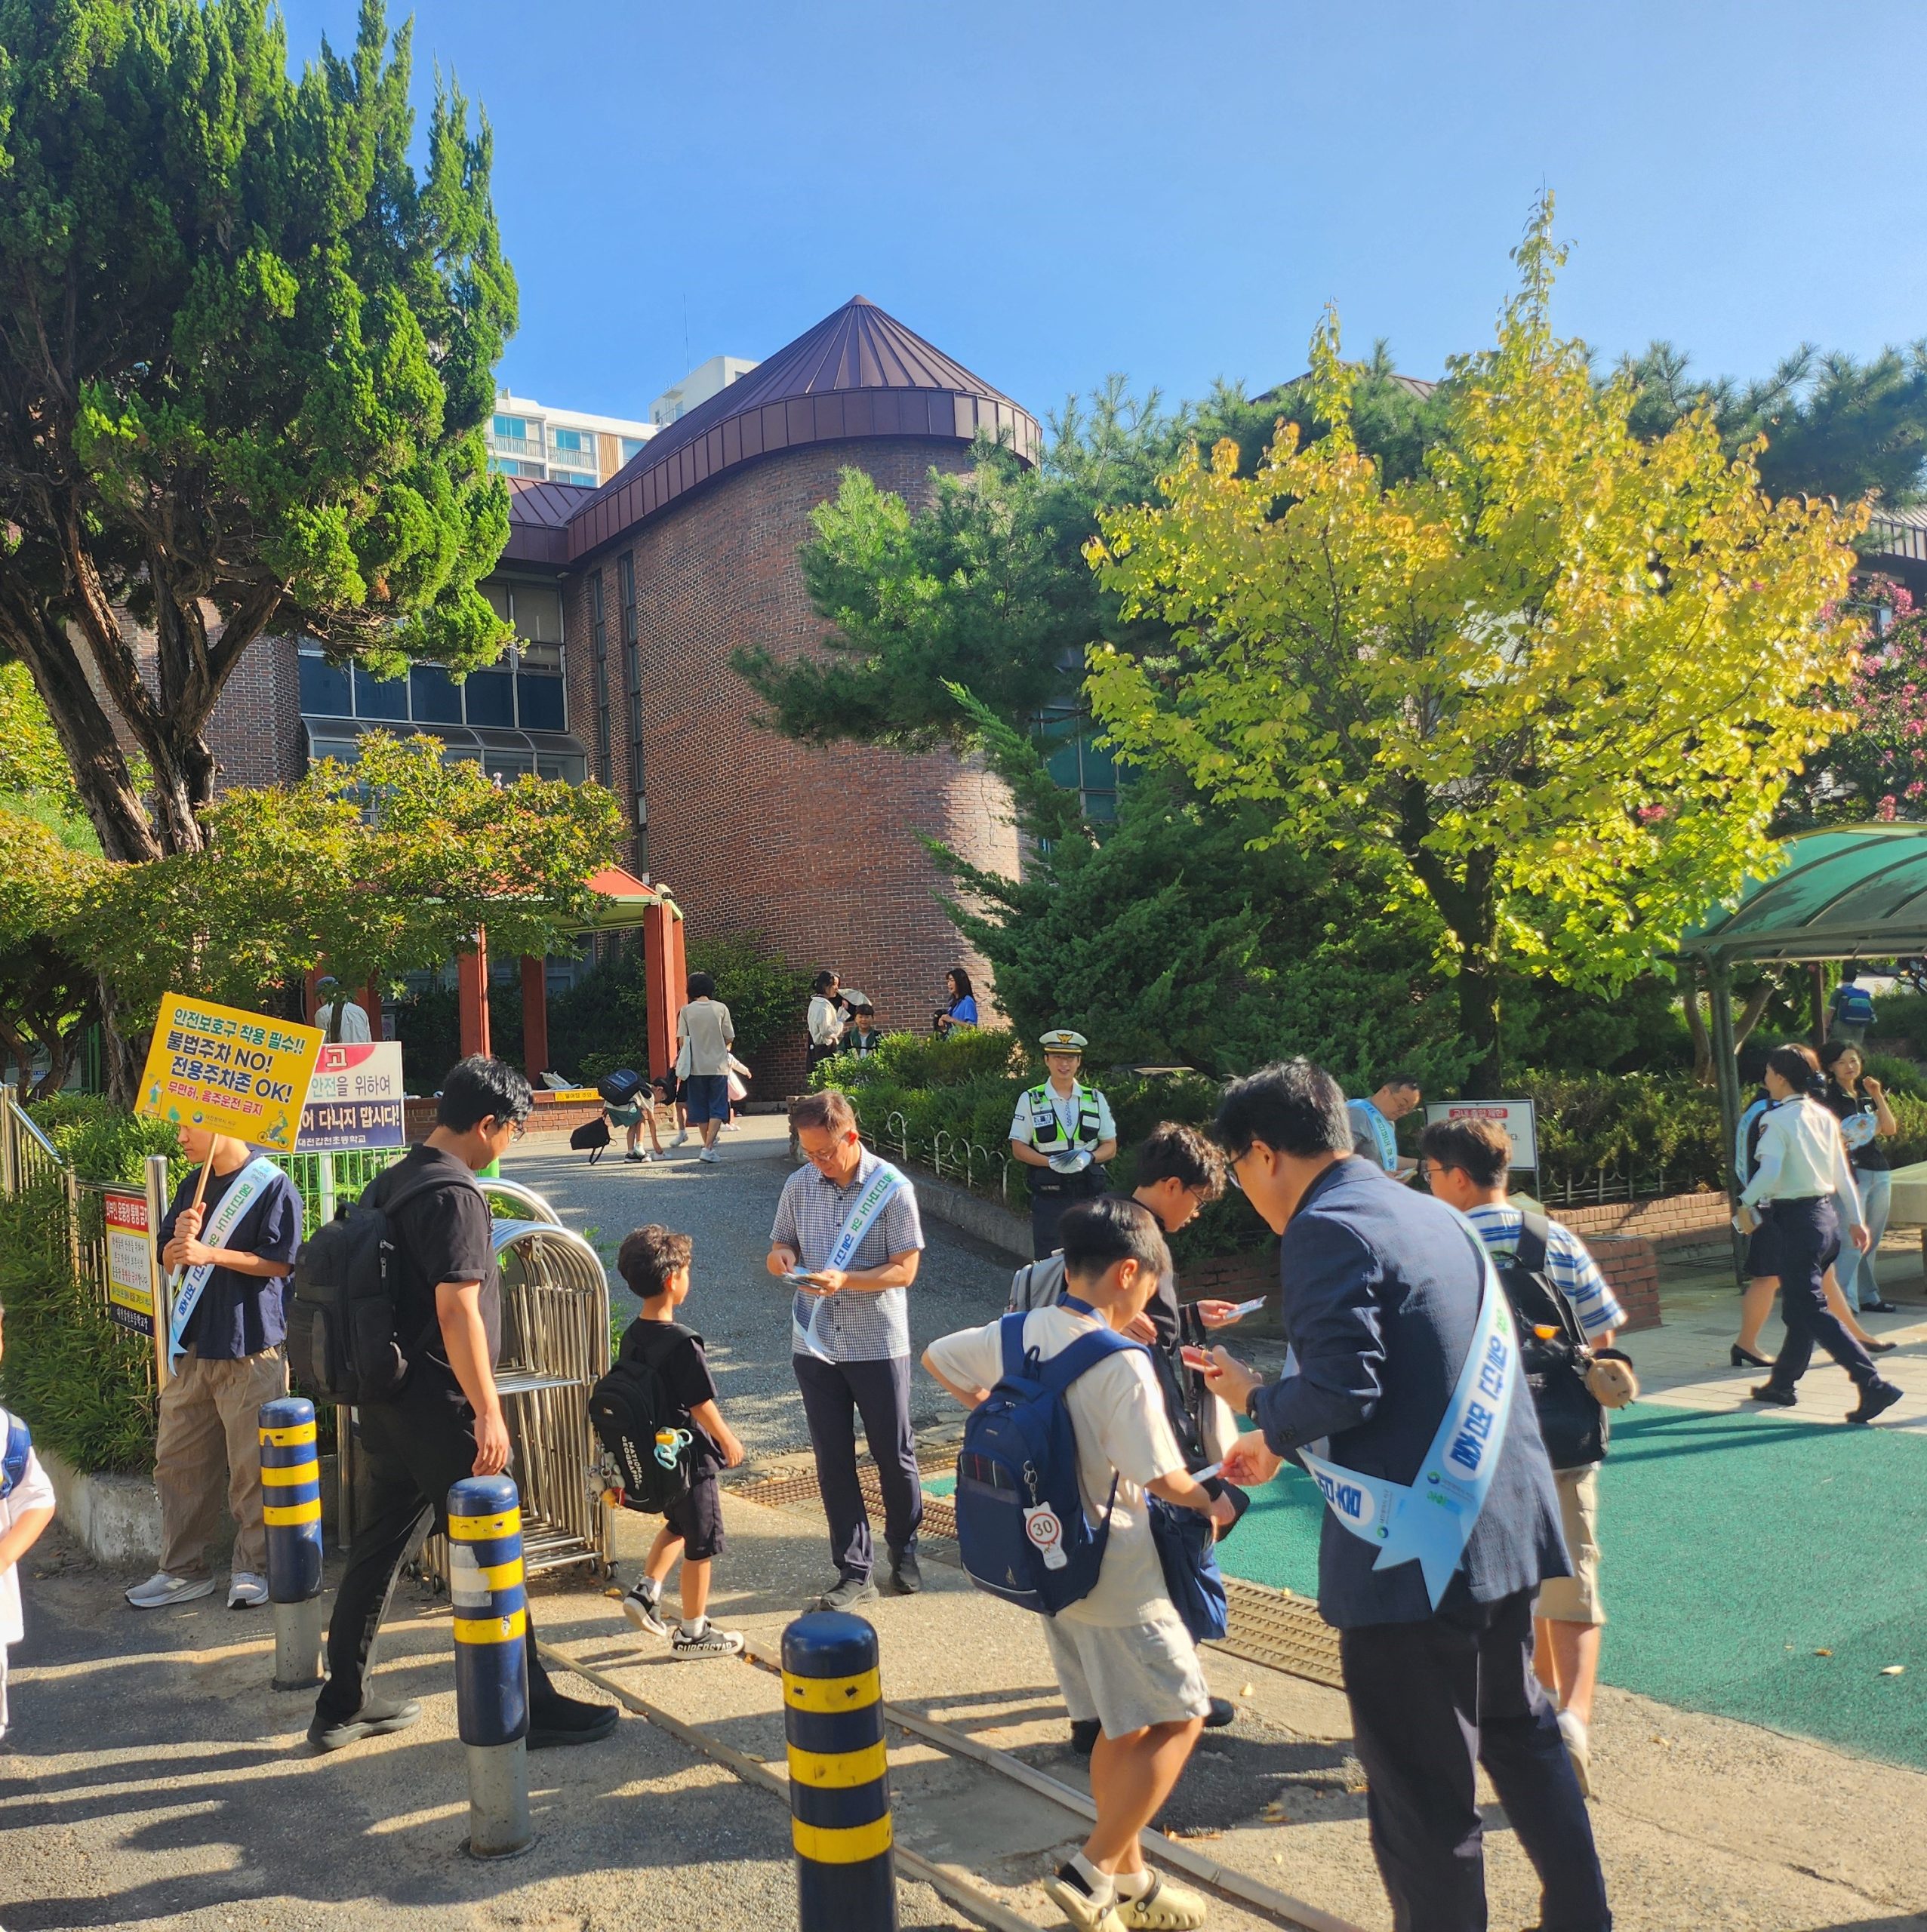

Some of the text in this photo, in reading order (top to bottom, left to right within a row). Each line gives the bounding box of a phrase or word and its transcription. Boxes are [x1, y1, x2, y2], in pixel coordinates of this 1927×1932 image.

[174, 1008, 306, 1054] 안전보호구 착용 필수!!
[166, 1030, 274, 1073] 불법주차 NO!
[326, 1048, 348, 1067] 고
[171, 1056, 293, 1103] 전용주차존 OK!
[312, 1074, 391, 1098] 안전을 위하여
[168, 1081, 264, 1116] 무면허, 음주운전 금지
[300, 1105, 400, 1131] 어 다니지 맙시다!
[297, 1134, 366, 1146] 대전갑천초등학교
[118, 1201, 130, 1223] 운동장
[131, 1204, 140, 1225] 통행
[215, 1183, 254, 1232] 횡단보도
[834, 1171, 896, 1266] 횡단보도 앞 일단
[208, 1233, 220, 1247] 앞
[178, 1283, 196, 1316] 멈춤
[1479, 1335, 1507, 1401] 일단
[1449, 1399, 1495, 1472] 멈춤
[622, 1435, 640, 1491] GEOGRAPHIC
[628, 1441, 643, 1484] NATIONAL
[1033, 1520, 1052, 1537] 30
[677, 1641, 732, 1652] SUPERSTAR
